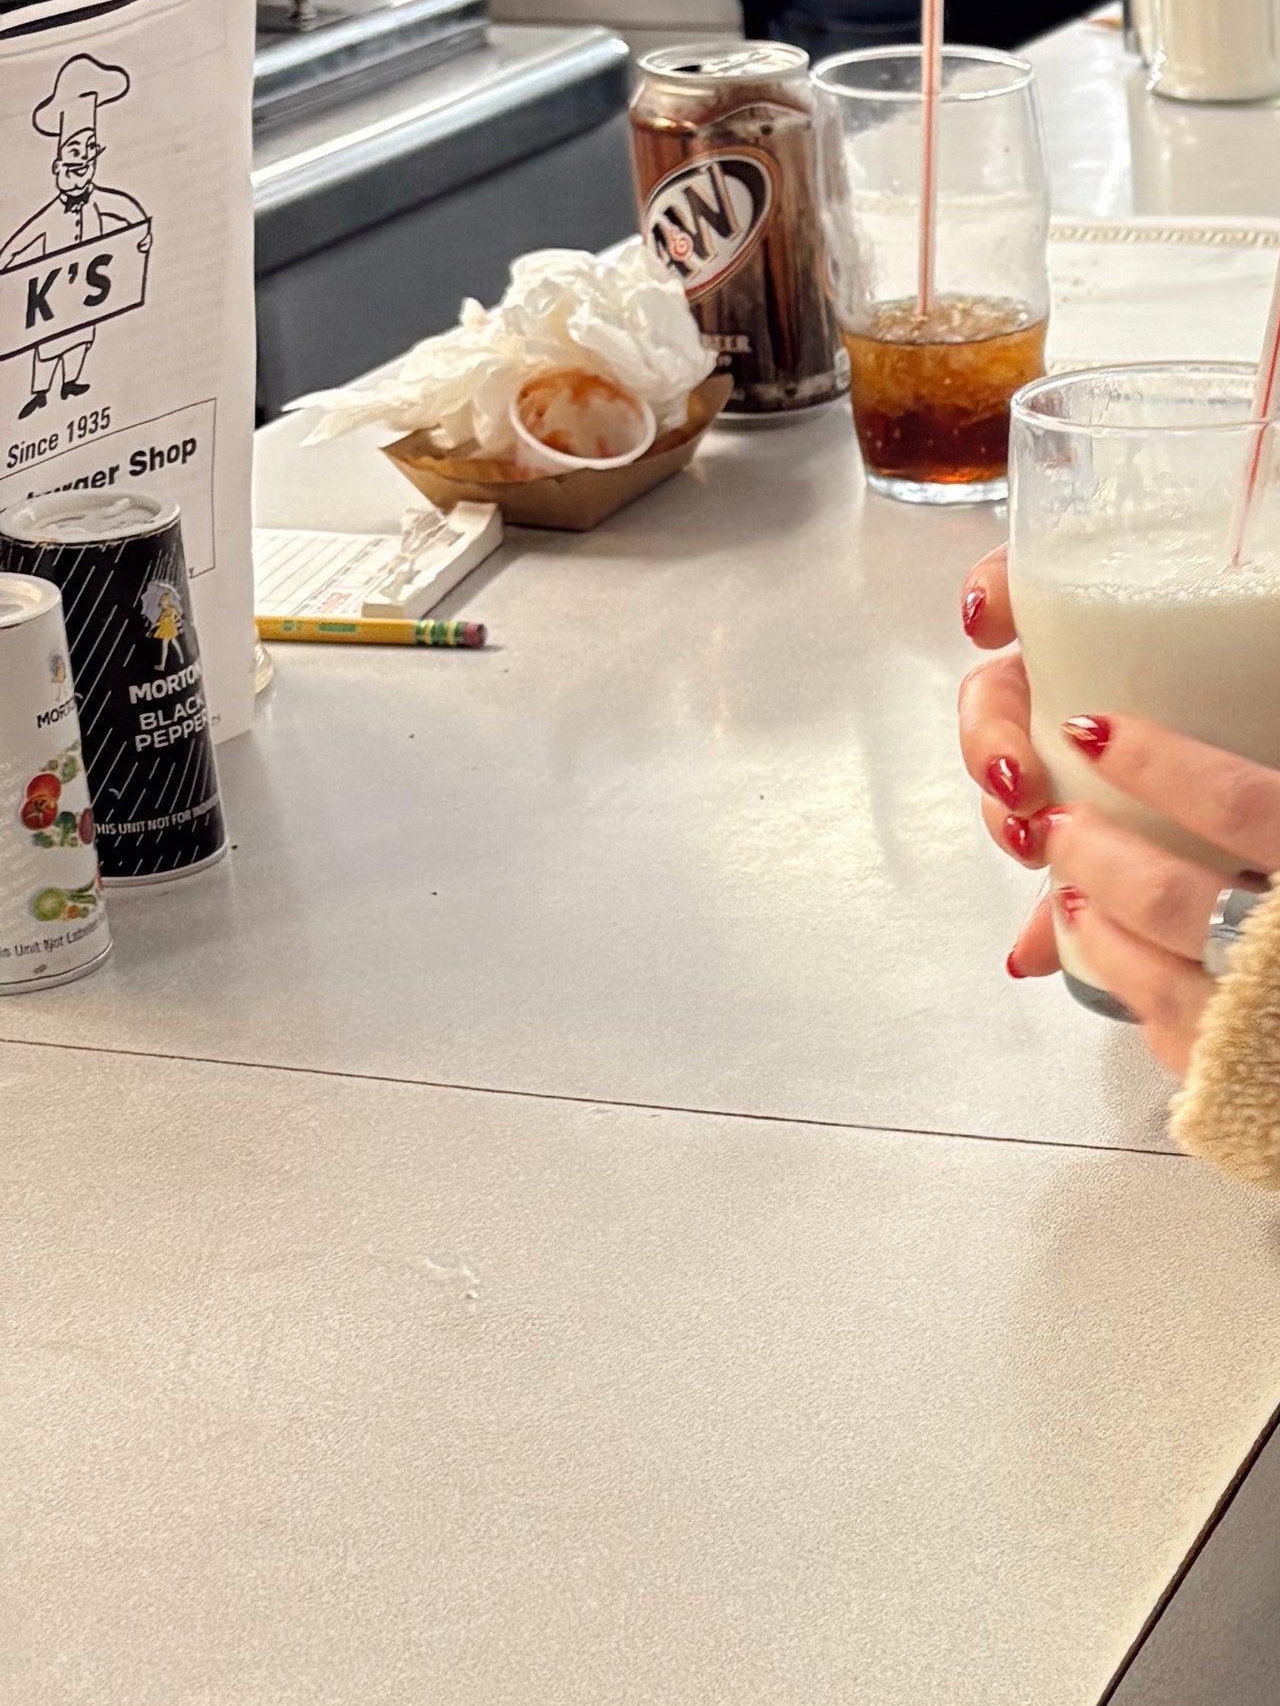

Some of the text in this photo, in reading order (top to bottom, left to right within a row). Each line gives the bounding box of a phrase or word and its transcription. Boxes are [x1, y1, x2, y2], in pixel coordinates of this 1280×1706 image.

[25, 253, 114, 329] K'S
[7, 406, 112, 468] Since 1935
[129, 437, 197, 477] Shop
[147, 816, 170, 831] NOT
